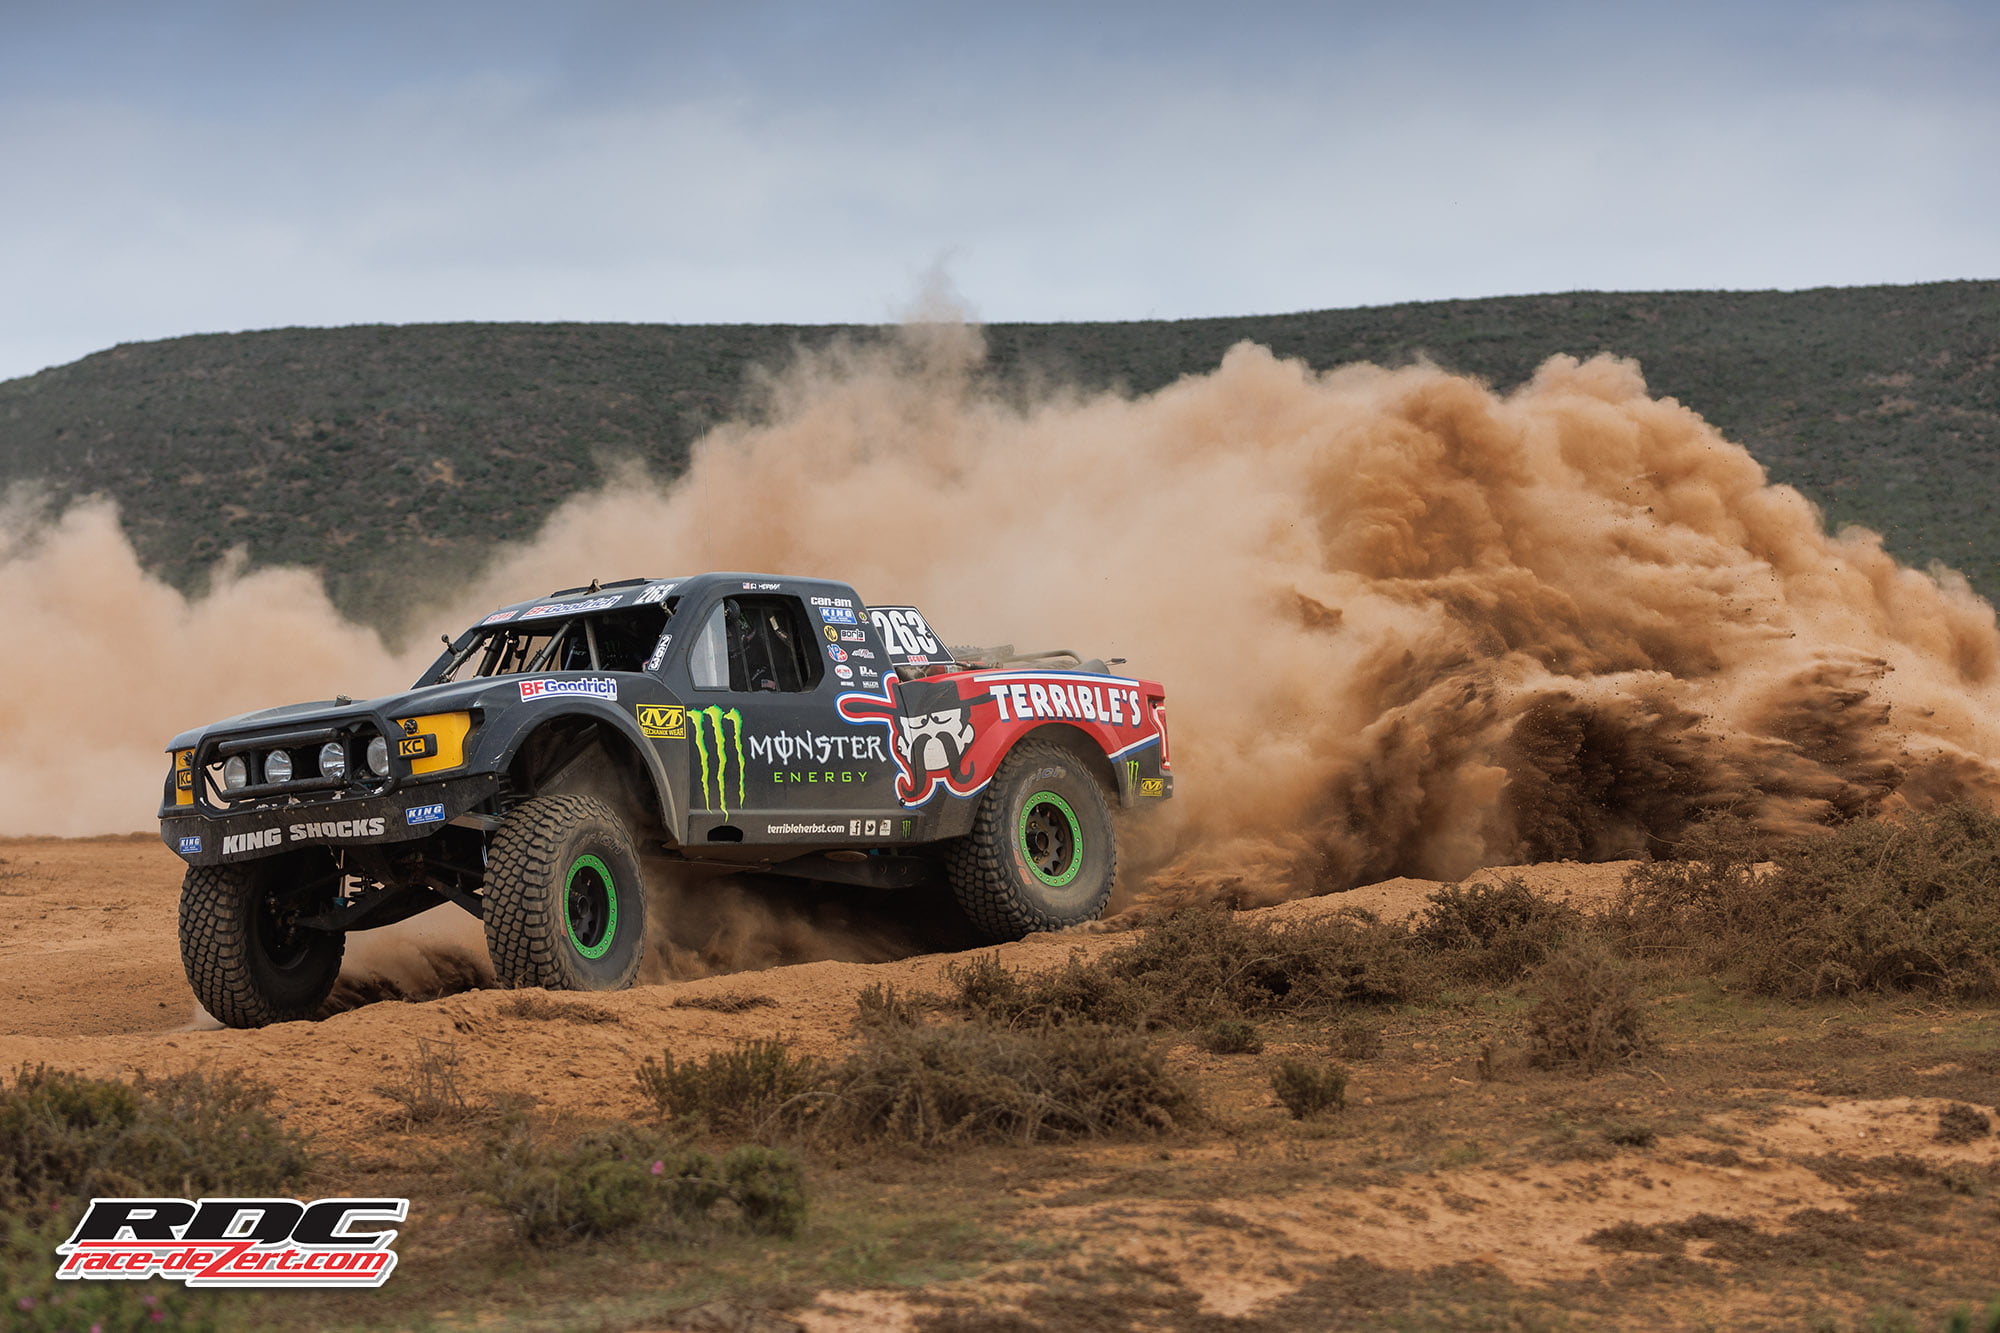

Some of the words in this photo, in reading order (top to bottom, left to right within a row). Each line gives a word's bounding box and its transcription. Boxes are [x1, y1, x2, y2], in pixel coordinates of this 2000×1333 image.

[641, 583, 674, 603] 263
[525, 597, 618, 616] BFGoodrich
[810, 596, 852, 607] can-am
[822, 608, 853, 617] KING
[871, 610, 938, 655] 263
[520, 678, 616, 697] BFGoodrich
[989, 684, 1142, 729] TERRIBLE'S
[402, 739, 423, 755] KC
[749, 730, 887, 765] MONSTER
[180, 771, 192, 785] KC
[774, 771, 868, 783] ENERGY
[408, 805, 442, 818] KING
[222, 828, 282, 855] KING
[290, 817, 386, 842] SHOCKS
[767, 823, 845, 834] terribleherbst.com
[180, 838, 200, 847] KING
